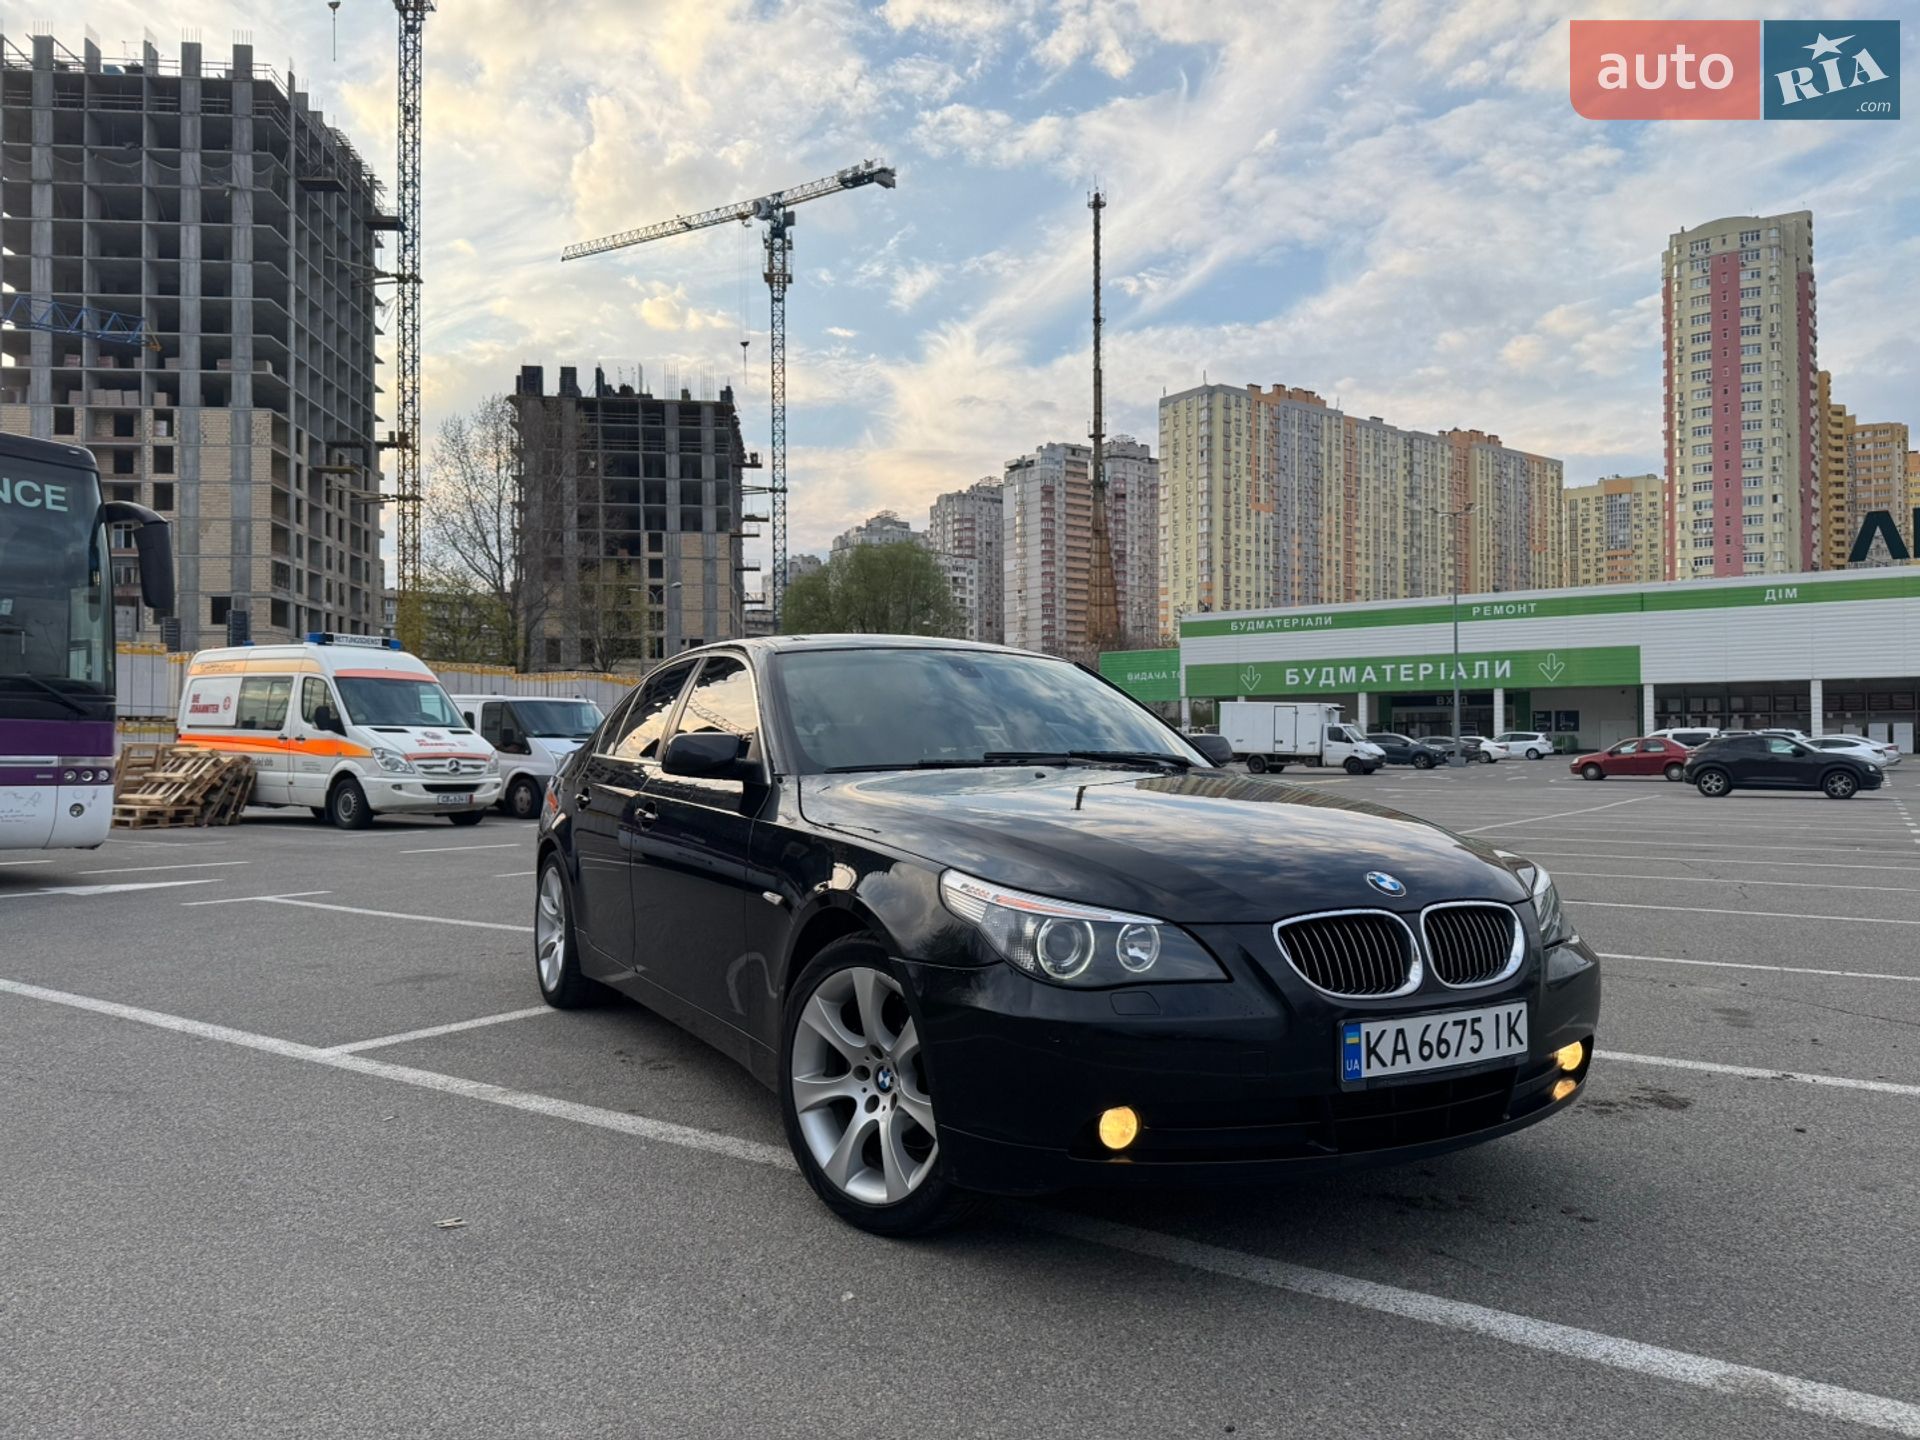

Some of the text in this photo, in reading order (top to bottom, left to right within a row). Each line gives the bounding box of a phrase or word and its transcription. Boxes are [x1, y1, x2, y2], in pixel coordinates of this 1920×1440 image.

[1764, 587, 1798, 602] ДІМ
[1472, 602, 1538, 617] РЕМОНТ
[1230, 615, 1333, 632] БУДМАТЕРІАЛИ
[1127, 671, 1168, 682] ВИДАЧА
[1285, 660, 1512, 687] БУДМАТЕРІАЛИ
[1436, 695, 1468, 706] ВХД
[1346, 1059, 1360, 1071] UA
